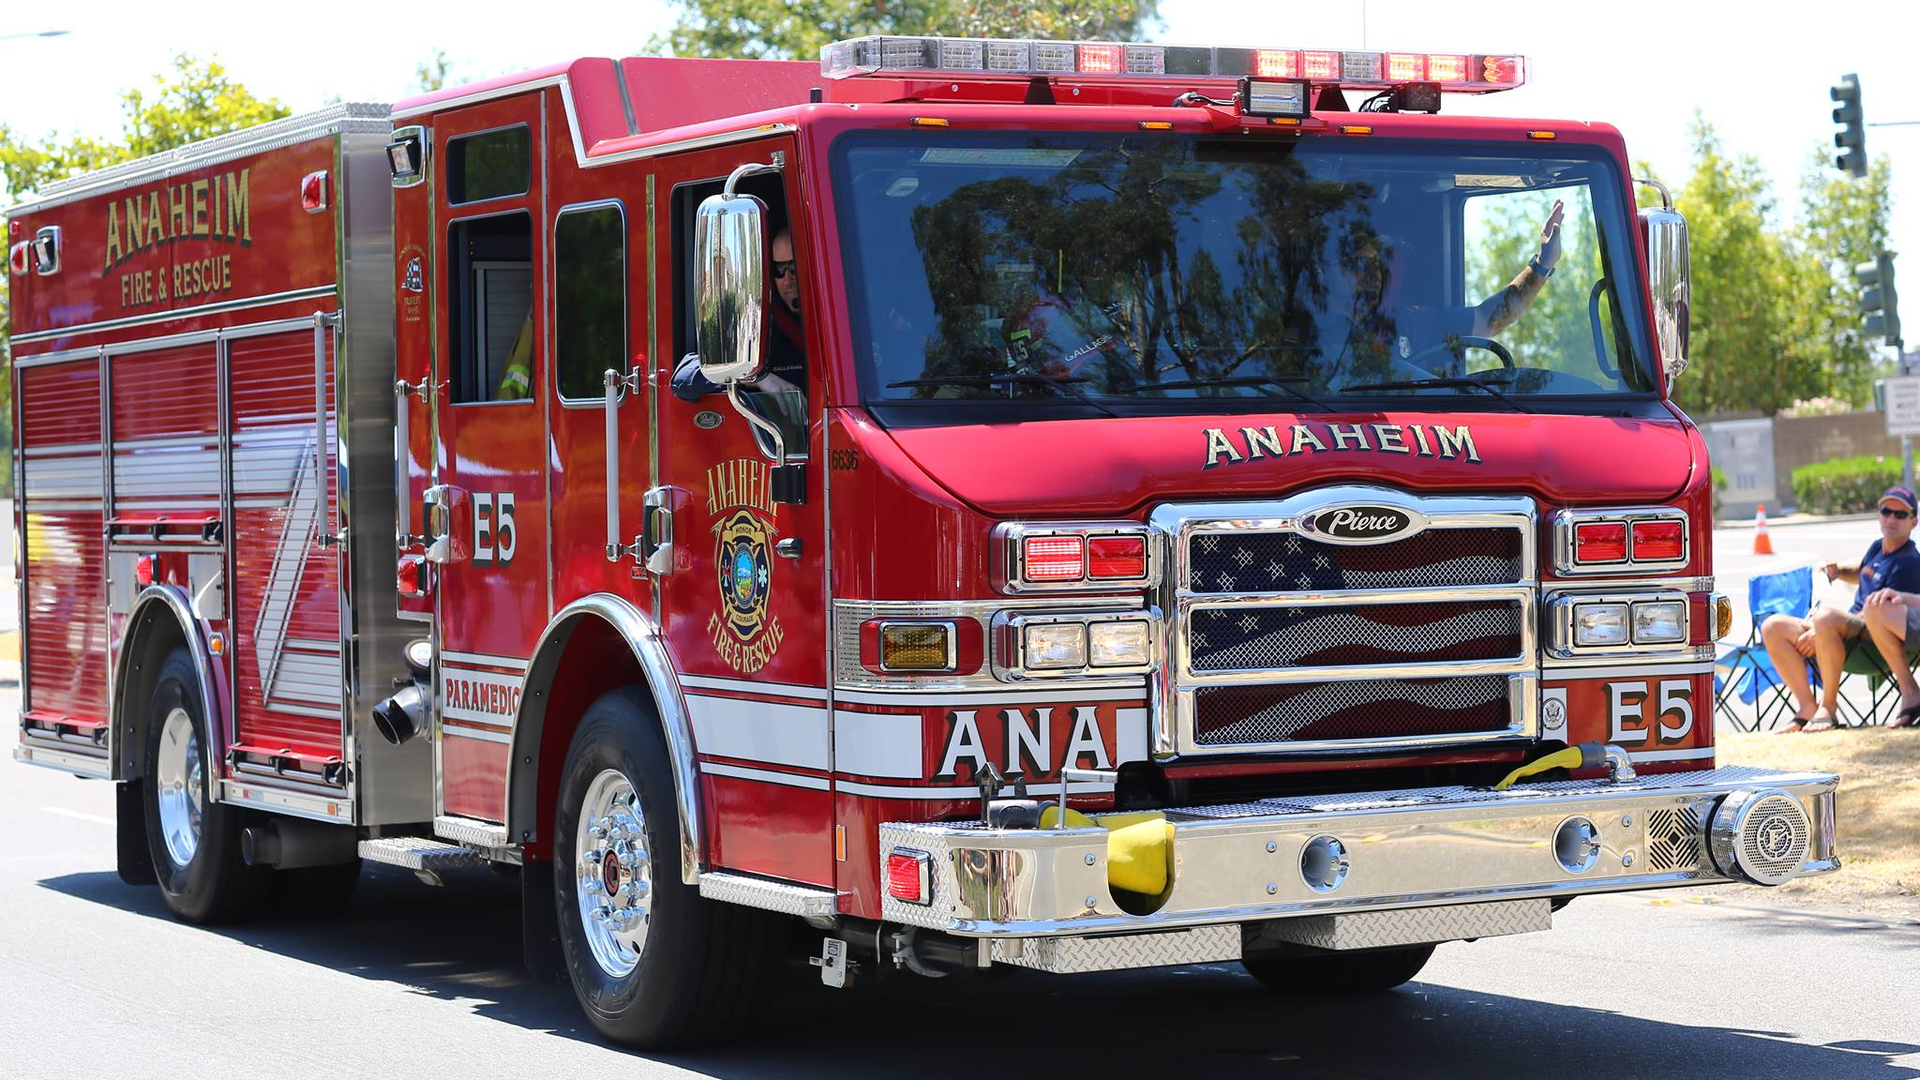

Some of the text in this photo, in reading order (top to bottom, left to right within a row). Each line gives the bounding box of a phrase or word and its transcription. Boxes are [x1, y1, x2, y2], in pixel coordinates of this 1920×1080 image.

[103, 168, 252, 276] ANAHEIM
[120, 254, 232, 308] FIRE & RESCUE
[832, 450, 859, 471] 6636
[1202, 423, 1483, 471] ANAHEIM
[471, 491, 517, 569] E5
[735, 526, 752, 536] HONOR
[1327, 508, 1399, 535] Pierce
[706, 611, 735, 664] FIRE
[742, 621, 786, 674] RESCUE
[736, 613, 754, 624] COURAGE
[1601, 678, 1694, 747] E5
[929, 705, 1116, 784] ANA
